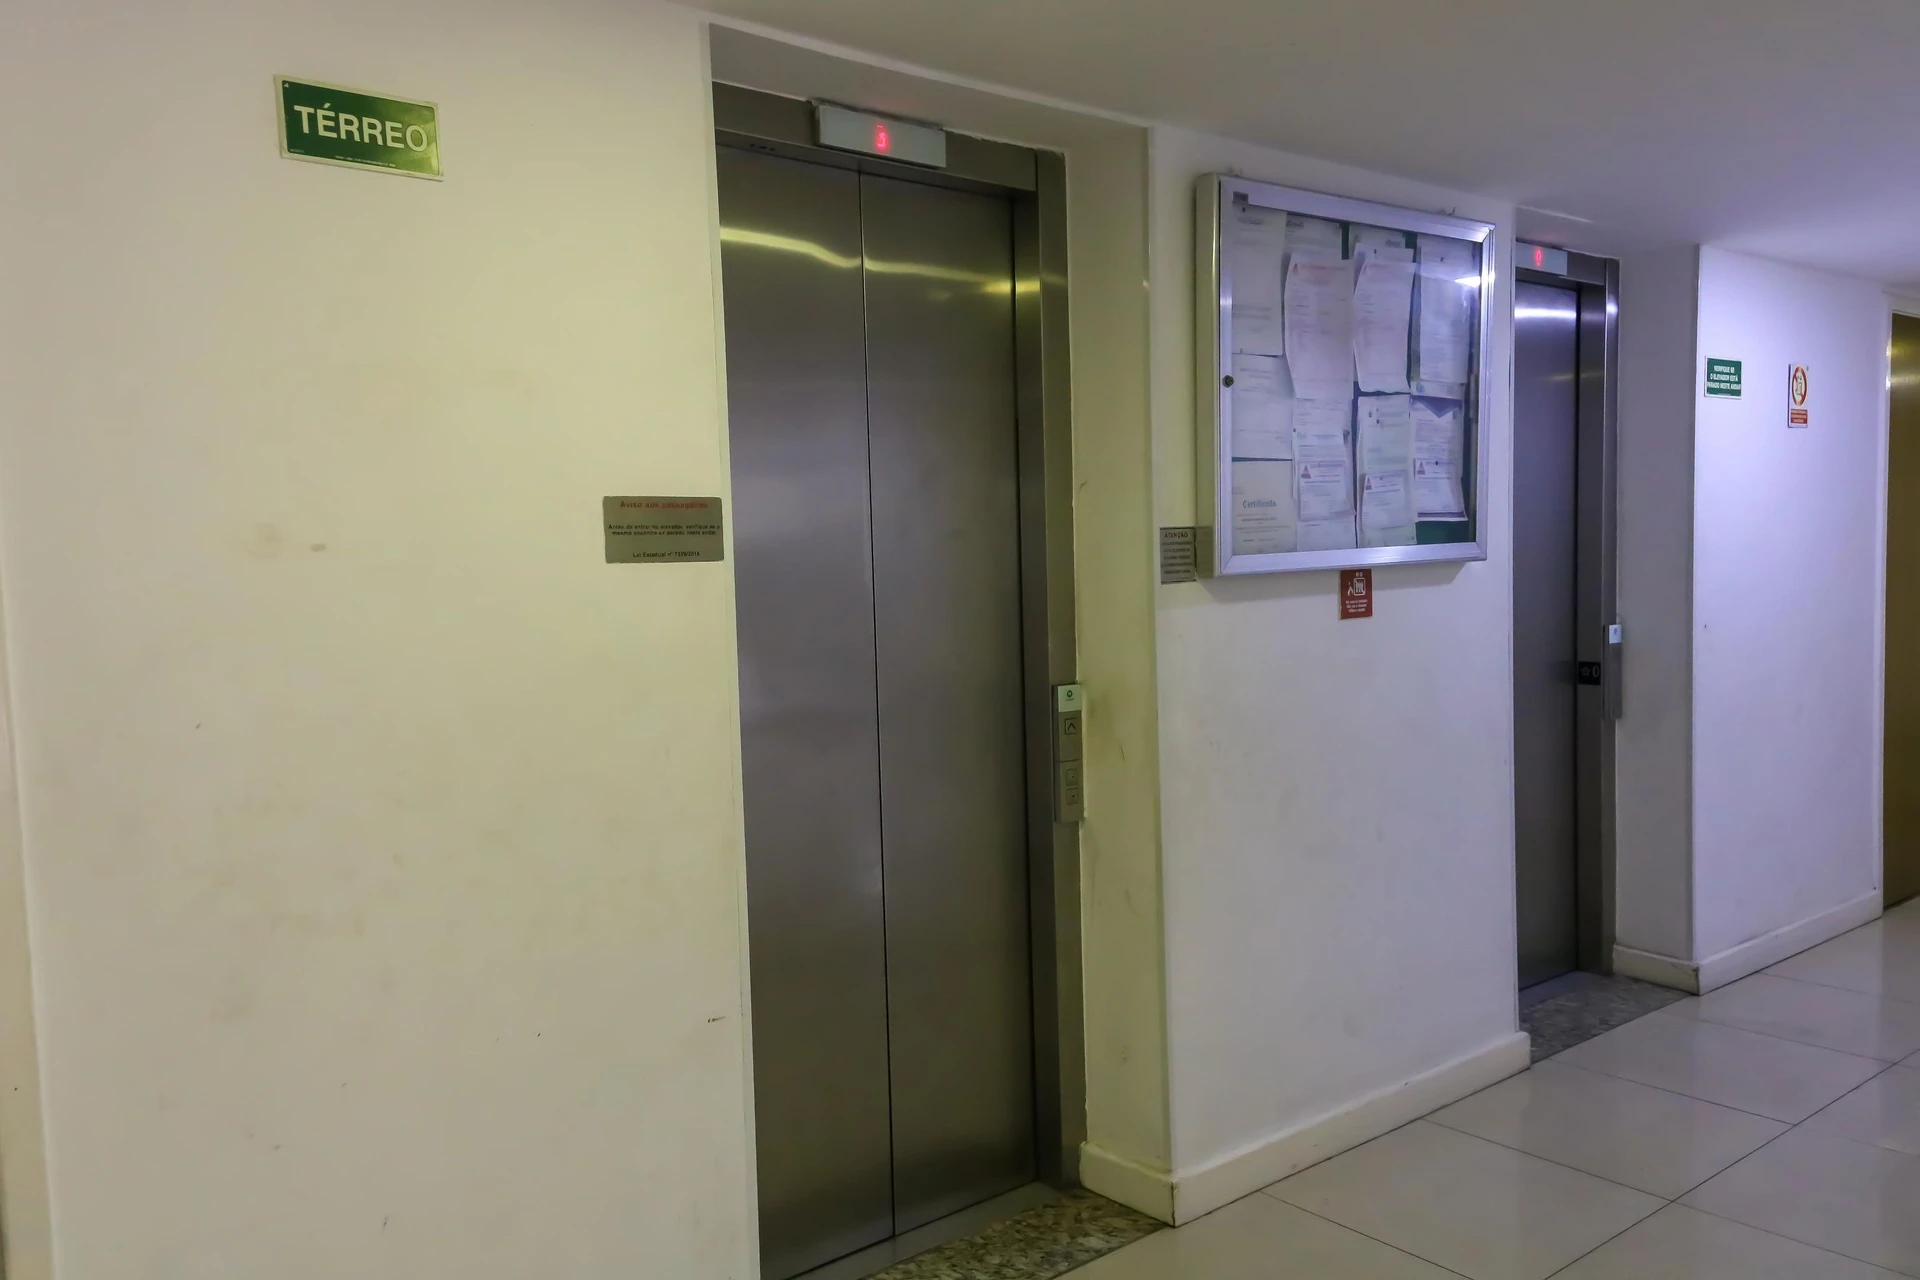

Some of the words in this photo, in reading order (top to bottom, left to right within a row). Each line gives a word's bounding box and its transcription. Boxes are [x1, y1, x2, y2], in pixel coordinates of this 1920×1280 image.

[293, 103, 428, 152] TÉRREO
[876, 124, 887, 148] 3
[1713, 373, 1729, 381] ELEVADOR
[1164, 531, 1189, 539] ATENÇÃO
